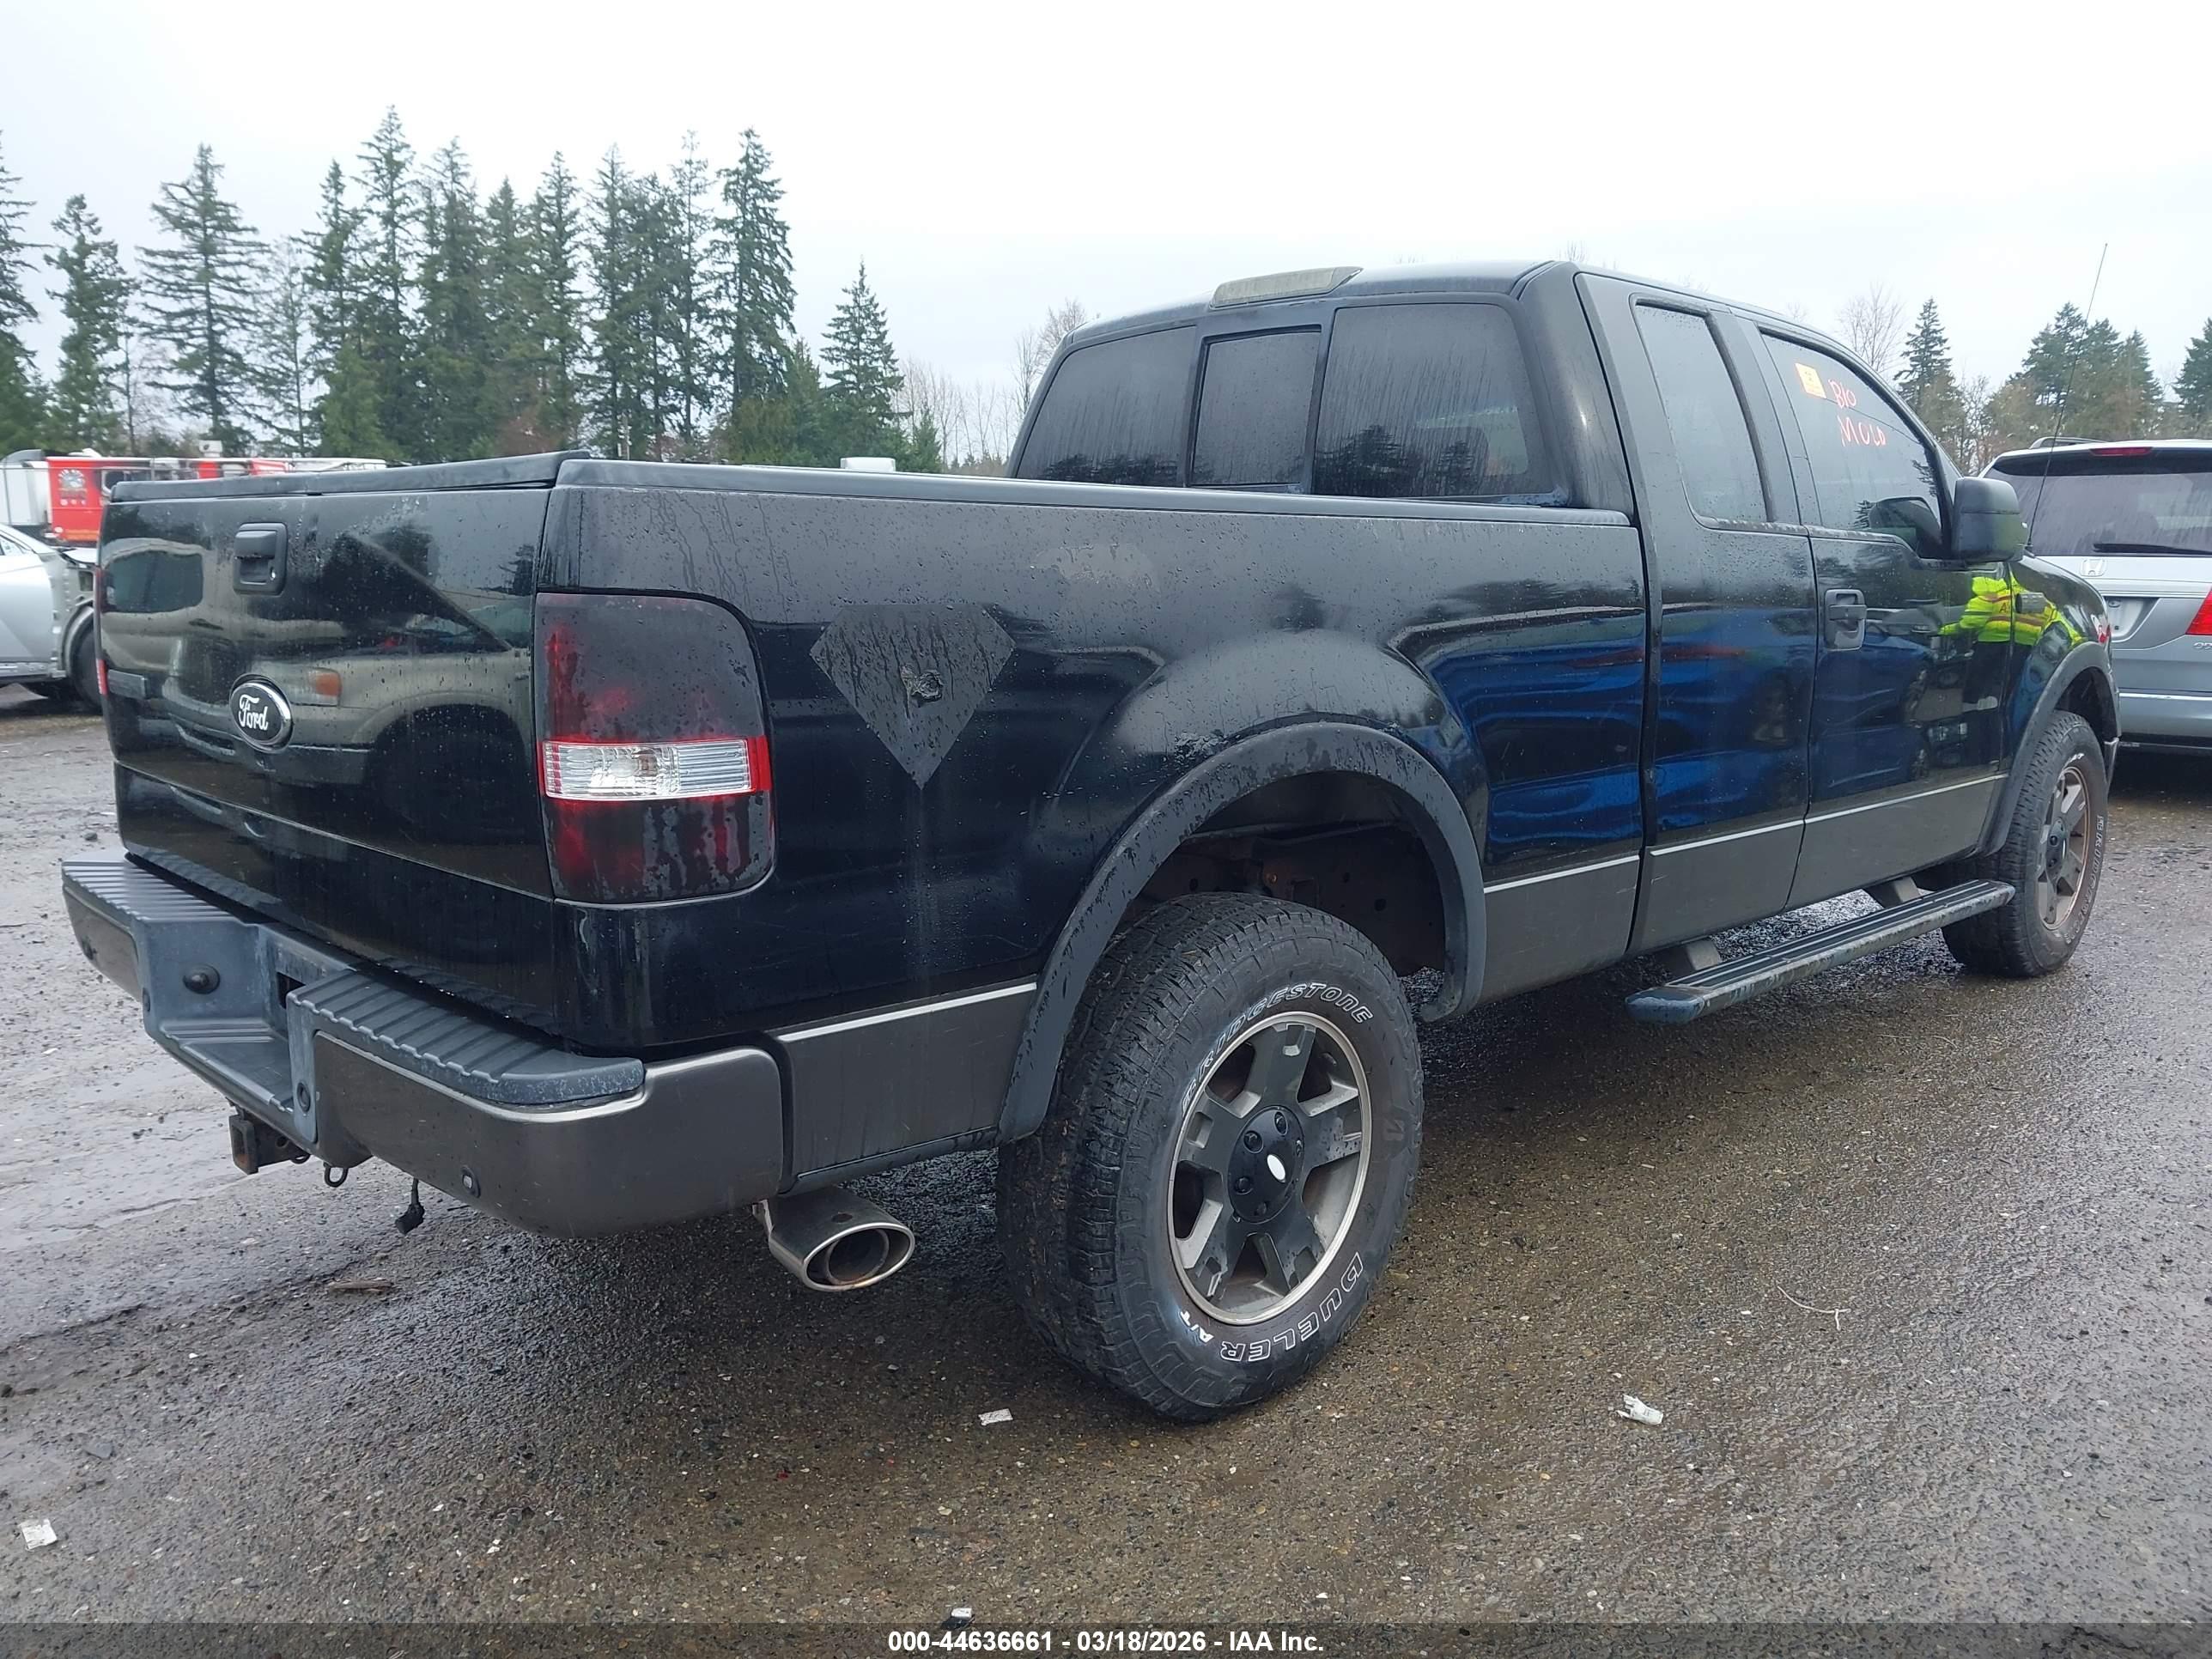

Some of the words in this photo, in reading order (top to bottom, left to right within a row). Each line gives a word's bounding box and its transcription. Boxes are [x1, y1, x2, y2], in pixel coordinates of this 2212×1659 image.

[1828, 380, 1856, 409] BIO
[1838, 416, 1887, 447] MOLD
[239, 694, 269, 731] Ford
[1182, 982, 1373, 1118] BRIDGESTONE
[1220, 1252, 1364, 1362] DUELER
[1180, 1310, 1214, 1343] A/T
